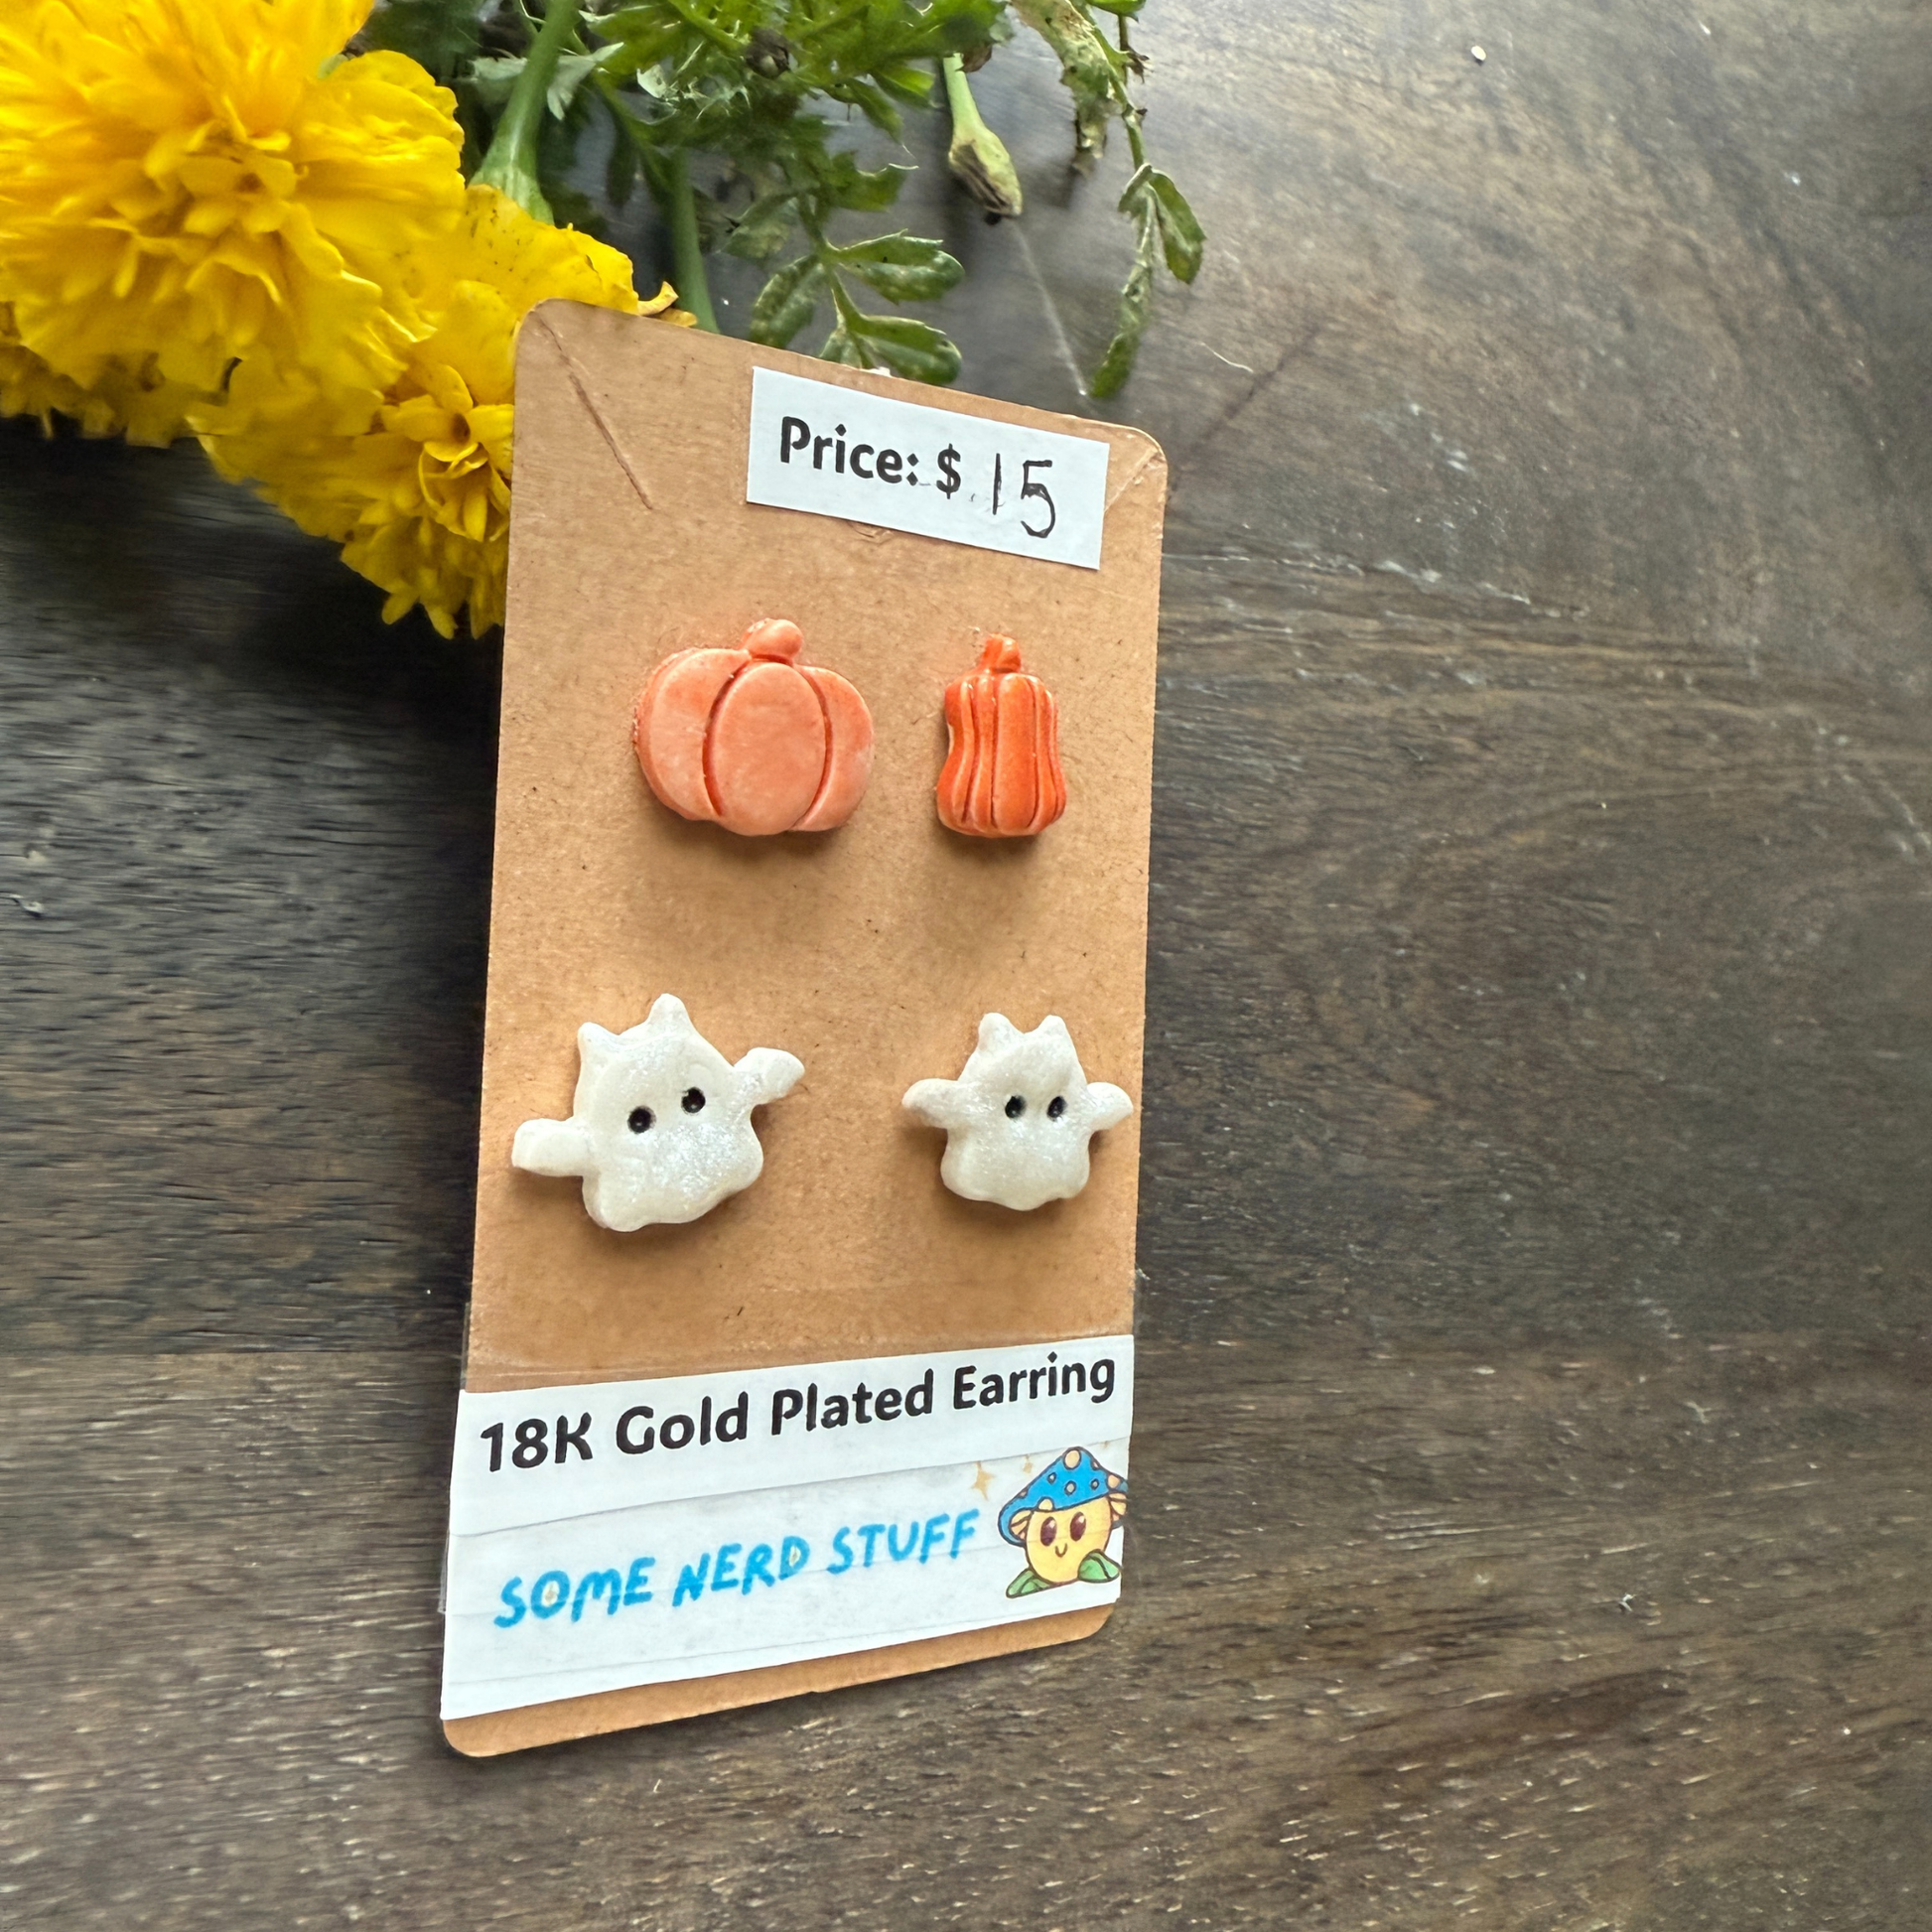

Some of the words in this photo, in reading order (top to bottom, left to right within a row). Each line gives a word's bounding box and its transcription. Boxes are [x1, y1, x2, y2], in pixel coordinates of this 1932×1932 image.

[779, 415, 919, 486] Price:
[480, 1412, 593, 1472] 18K
[616, 1391, 749, 1455] Gold
[770, 1369, 933, 1436] Plated
[952, 1351, 1116, 1410] Earring
[493, 1556, 656, 1628] SOME
[671, 1540, 809, 1607] NERD
[825, 1508, 981, 1575] STUFF
